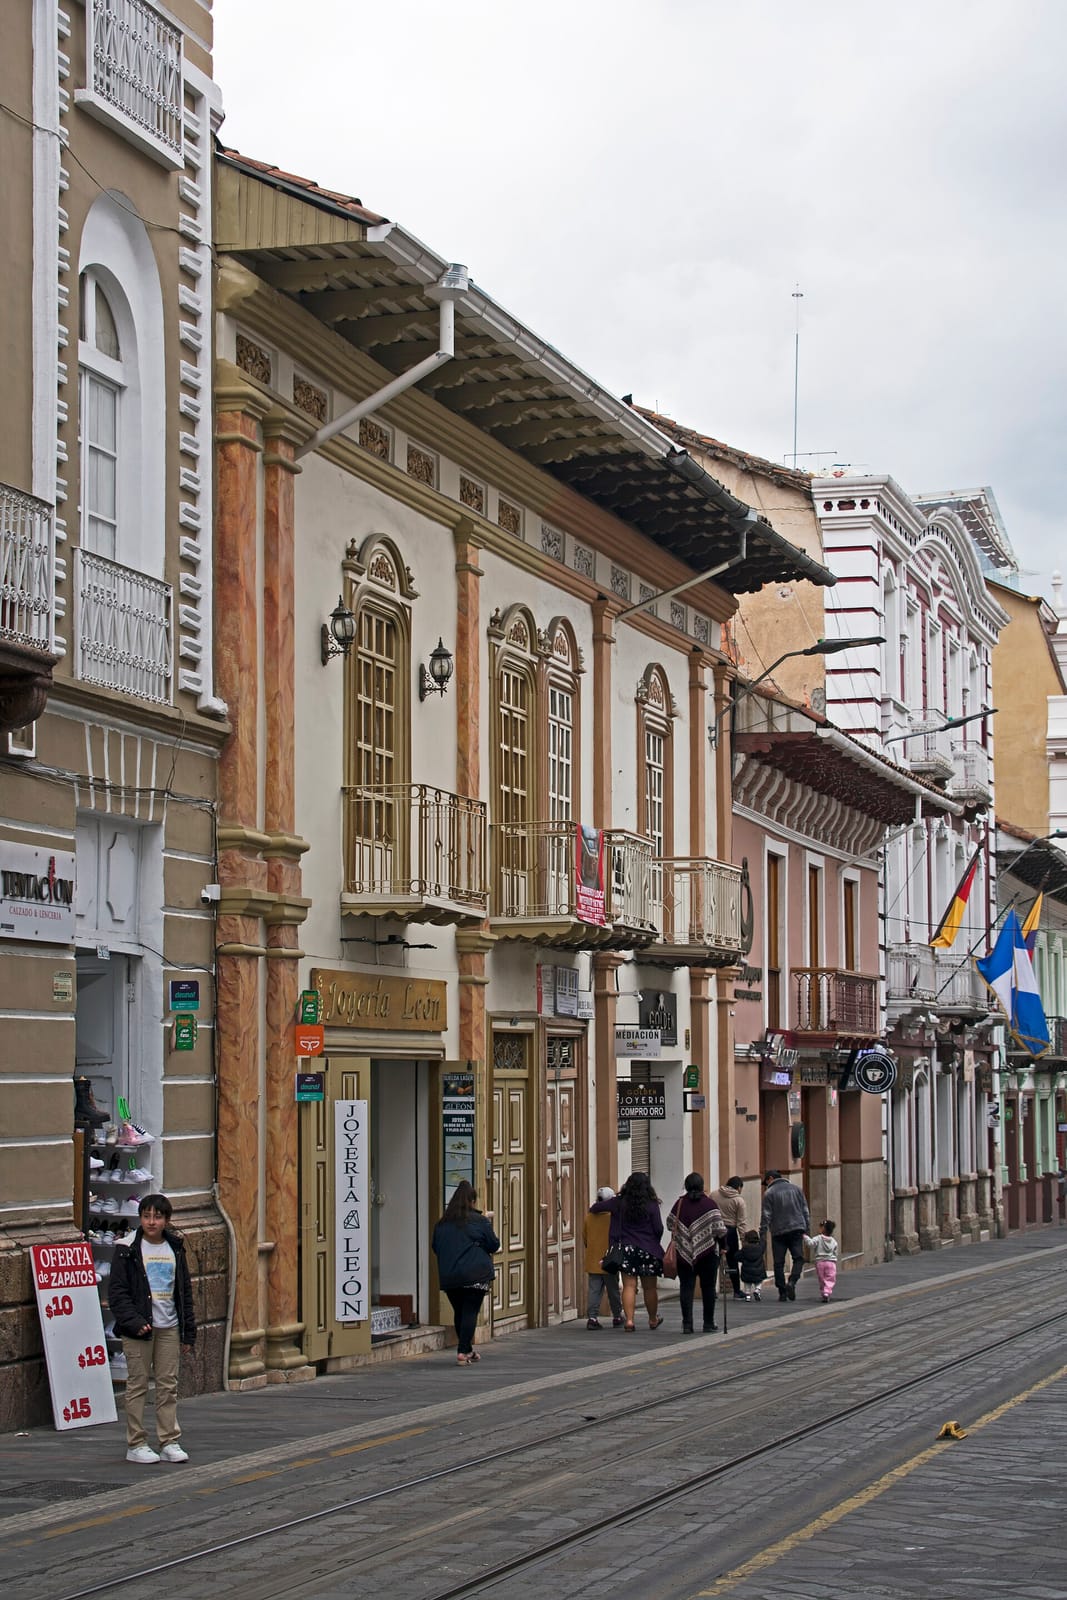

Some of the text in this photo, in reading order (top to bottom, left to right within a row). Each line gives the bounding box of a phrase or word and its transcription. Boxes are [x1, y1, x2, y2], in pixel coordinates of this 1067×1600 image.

[9, 906, 33, 917] CALZADO
[325, 979, 392, 1024] Joyería
[401, 983, 440, 1021] León
[615, 1030, 660, 1040] MEDIACIÓN
[620, 1096, 665, 1105] JOYERIA
[620, 1107, 664, 1116] COMPRO ORO
[341, 1104, 363, 1317] JOYERIA LEÓN
[39, 1246, 93, 1268] OFERTA
[38, 1269, 94, 1287] de ZAPATOS
[45, 1295, 73, 1320] $10
[78, 1345, 106, 1370] $13
[63, 1397, 92, 1422] $15
